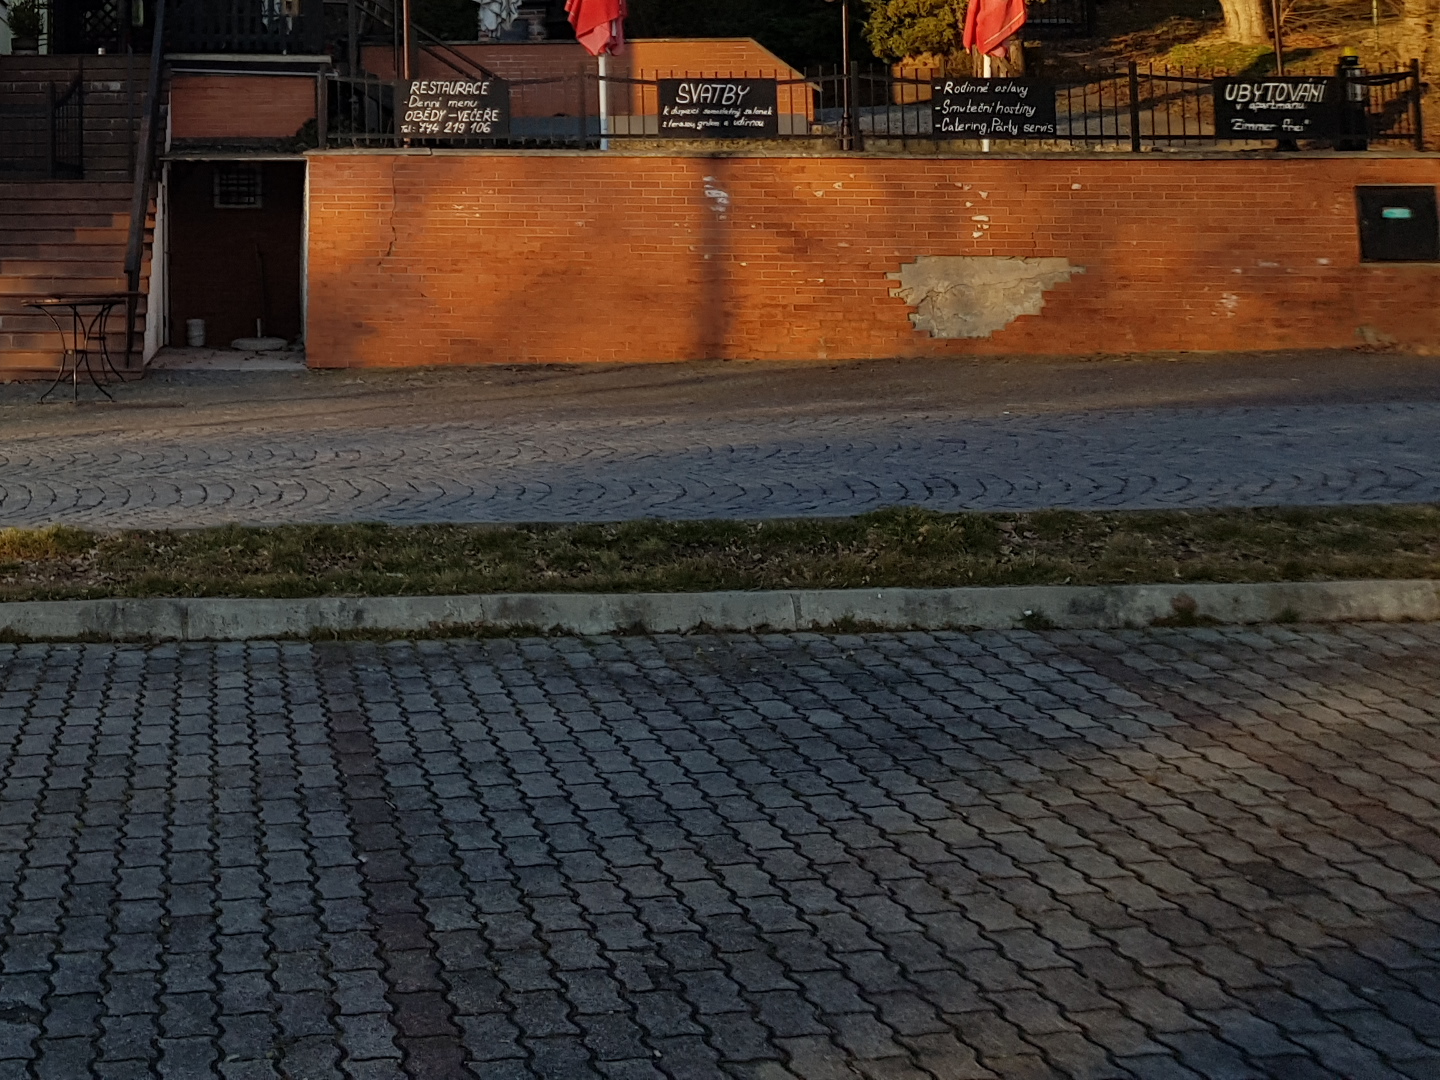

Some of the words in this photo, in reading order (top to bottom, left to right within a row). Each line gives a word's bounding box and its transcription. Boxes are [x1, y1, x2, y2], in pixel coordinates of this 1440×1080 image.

[410, 81, 489, 95] RESTAURACE
[676, 83, 750, 105] SVATBY
[995, 82, 1028, 98] oslavy
[1225, 78, 1327, 102] UBYTOVÁNÍ
[996, 101, 1036, 117] hostiny
[444, 122, 465, 133] 219
[470, 122, 491, 133] 106
[1023, 123, 1054, 133] servis
